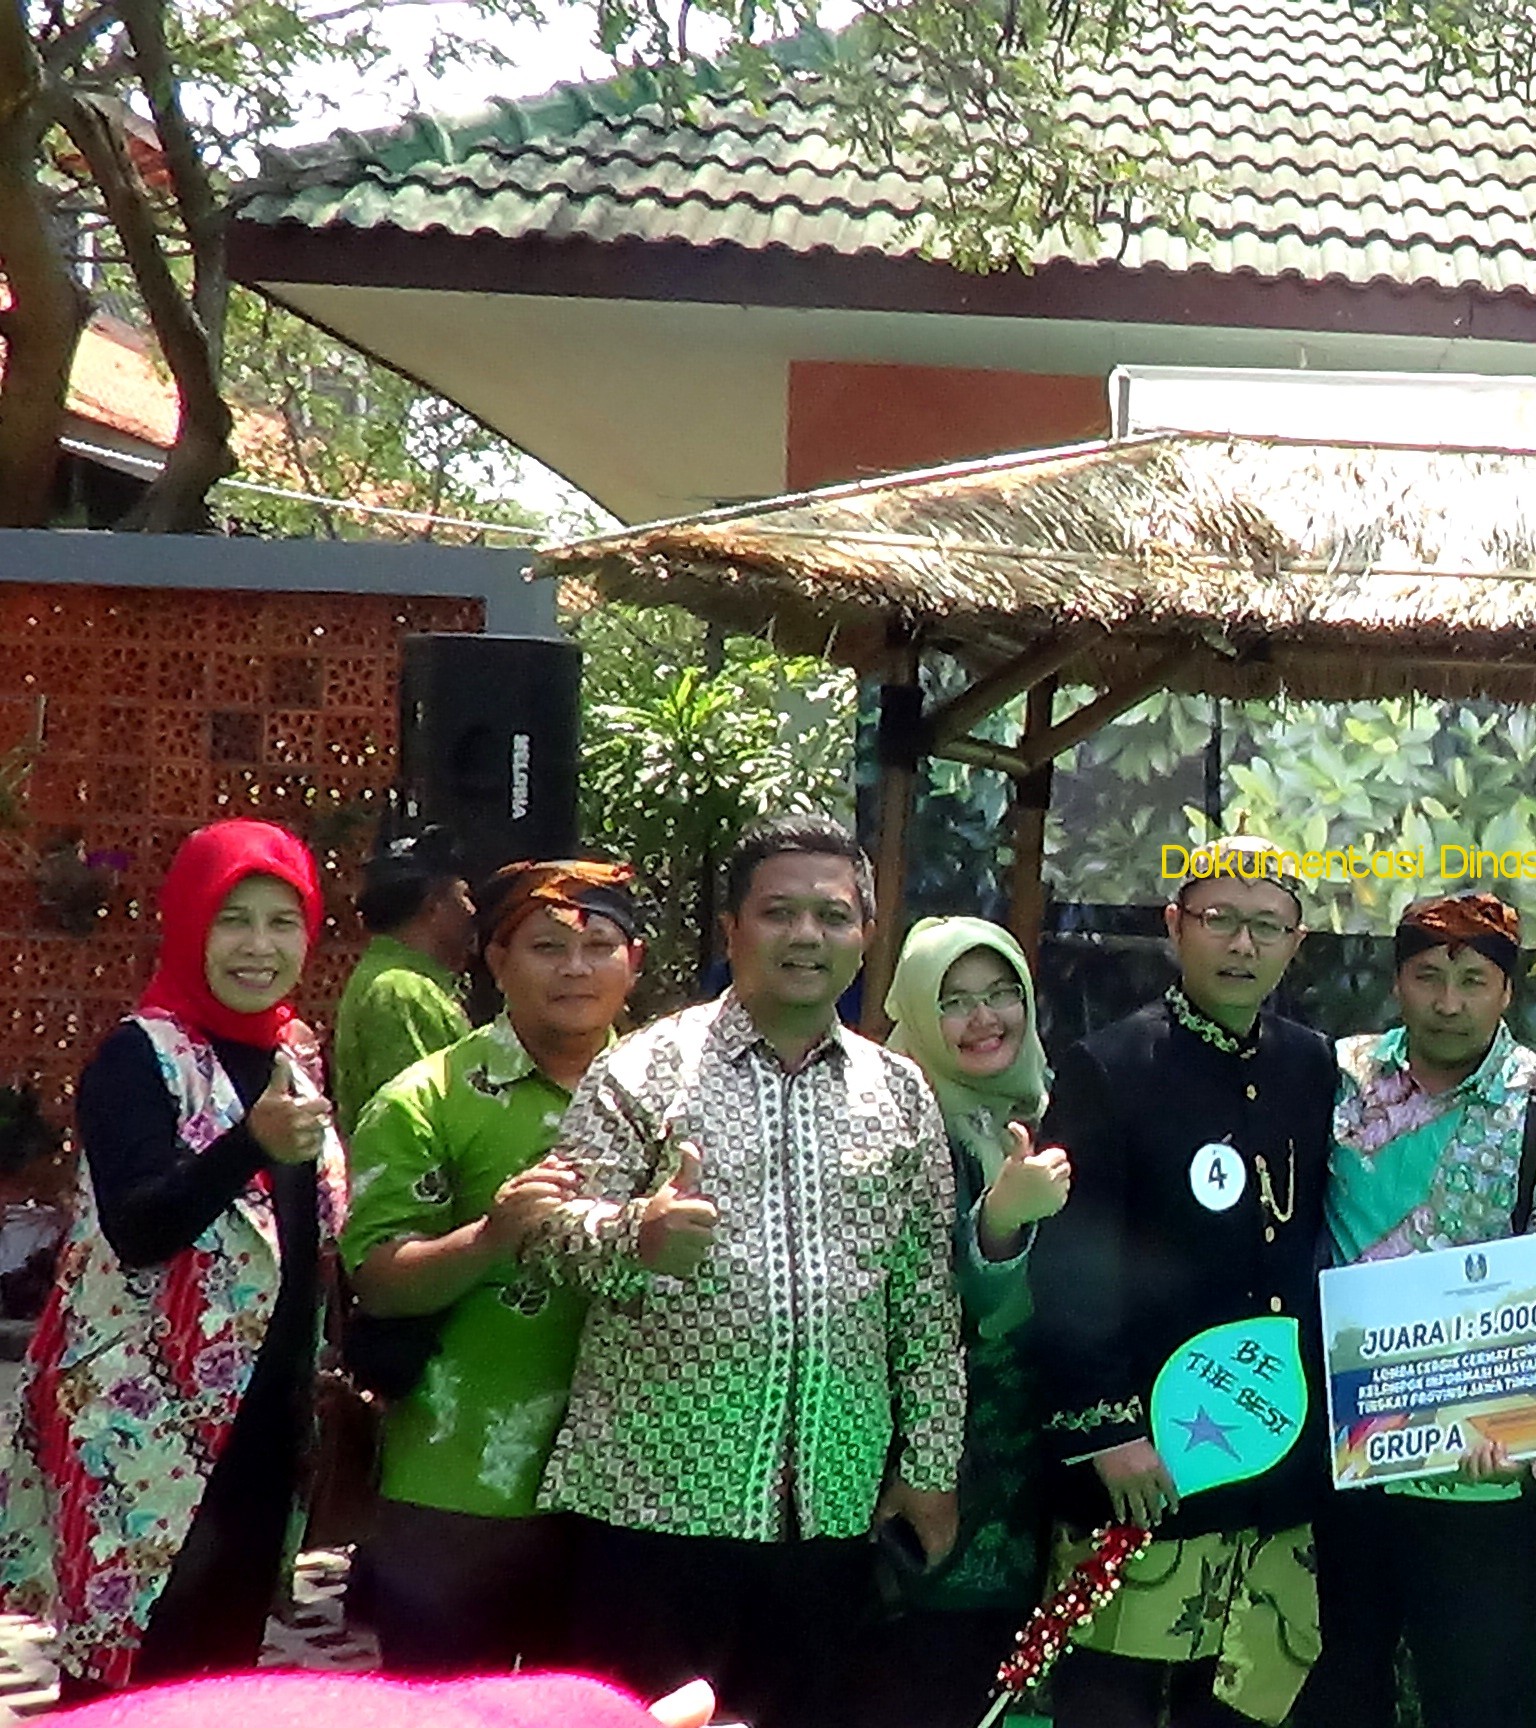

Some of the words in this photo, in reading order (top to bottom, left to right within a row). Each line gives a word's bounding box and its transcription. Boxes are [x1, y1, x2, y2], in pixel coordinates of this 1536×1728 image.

[1207, 1157, 1229, 1191] 4
[1358, 1318, 1447, 1358] JUARA
[1230, 1338, 1286, 1385] BE
[1184, 1350, 1238, 1395] THE
[1232, 1386, 1296, 1437] BEST
[1366, 1423, 1445, 1463] GRUP
[1442, 1421, 1464, 1449] A
